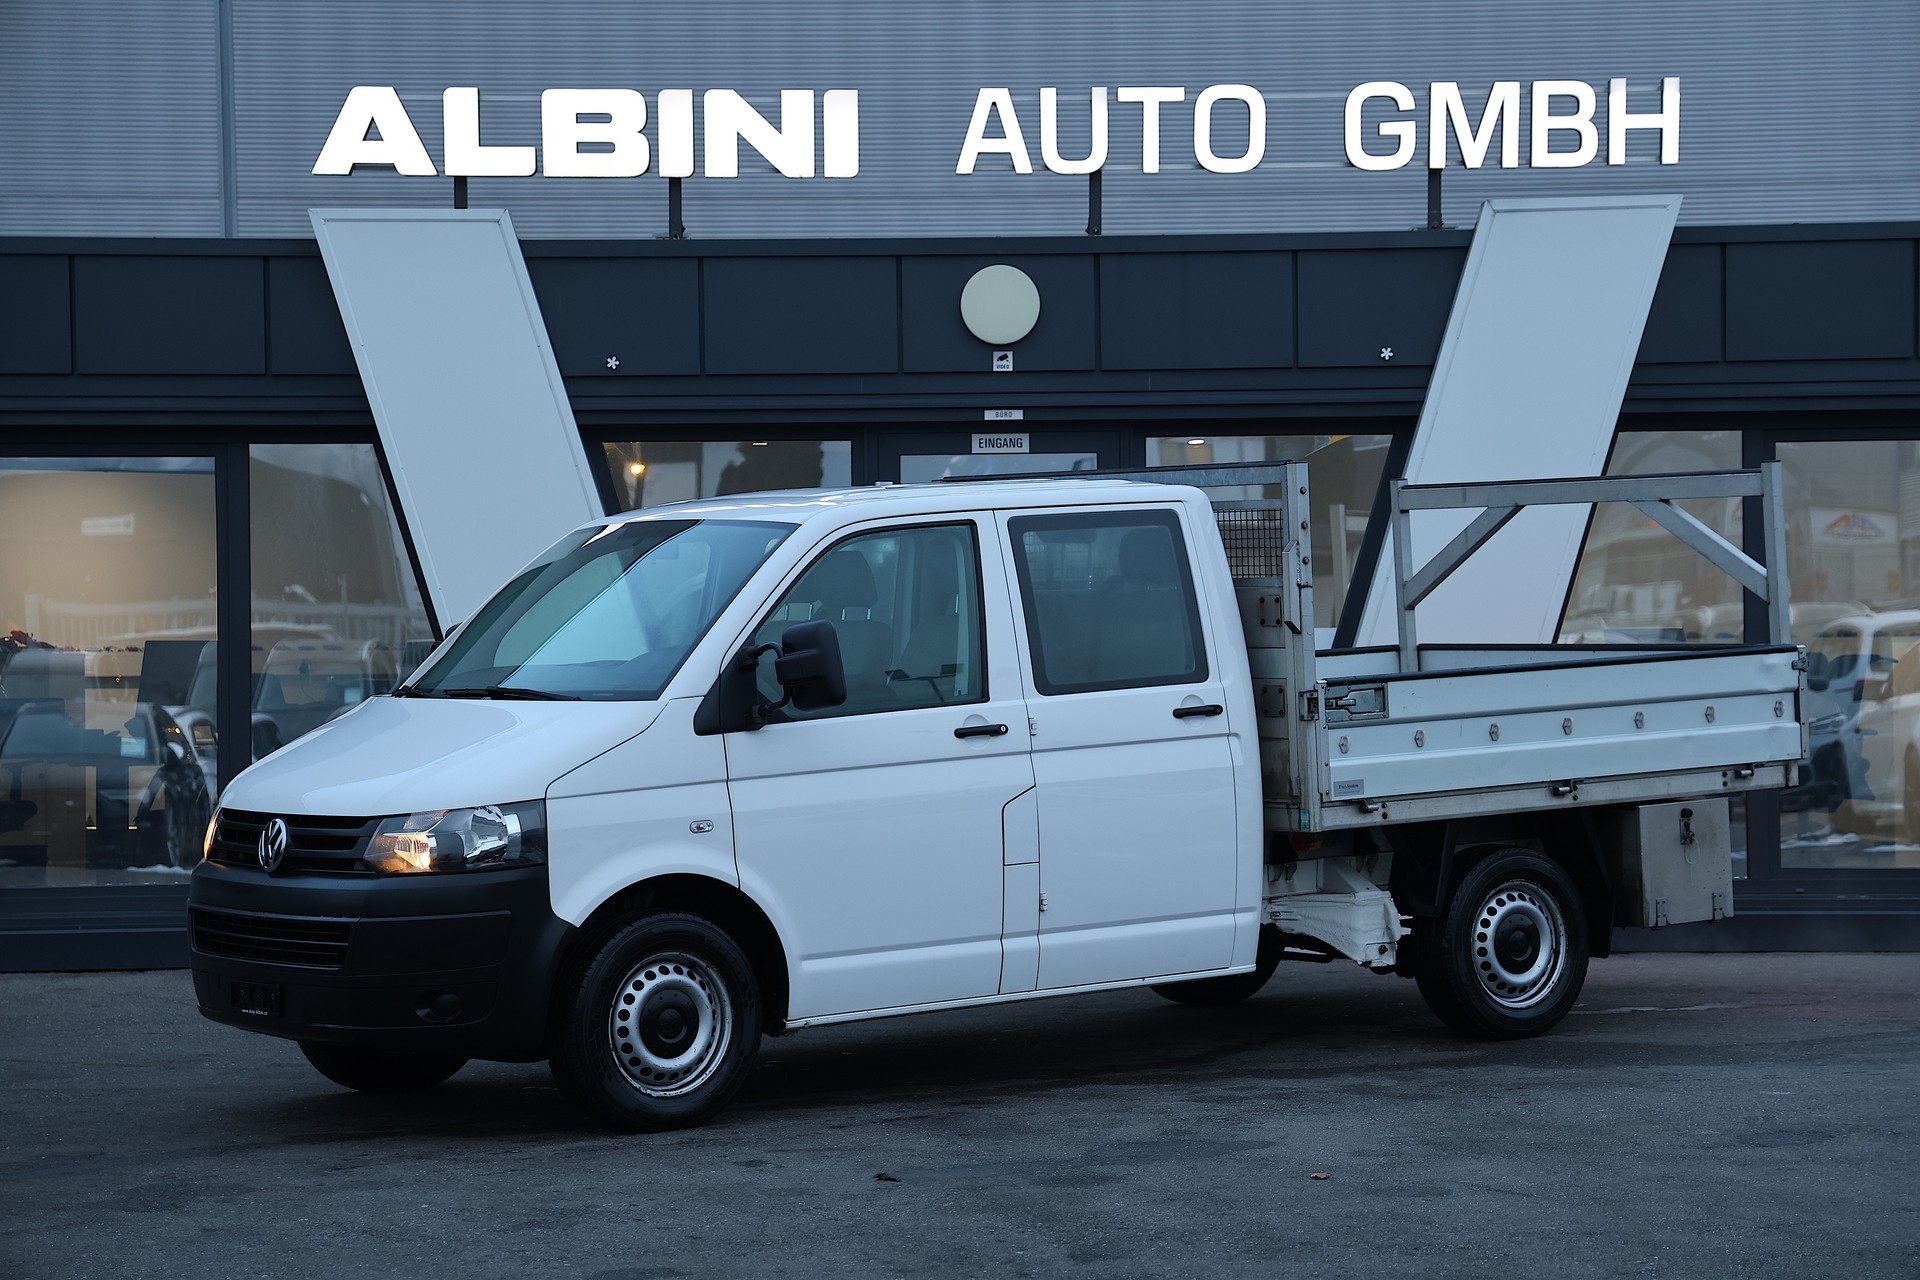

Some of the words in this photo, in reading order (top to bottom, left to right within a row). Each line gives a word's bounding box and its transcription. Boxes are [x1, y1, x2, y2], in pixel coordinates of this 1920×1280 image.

[312, 86, 859, 178] ALBINI
[955, 85, 1266, 174] AUTO
[1345, 77, 1681, 170] GMBH
[978, 437, 1023, 449] EINGANG
